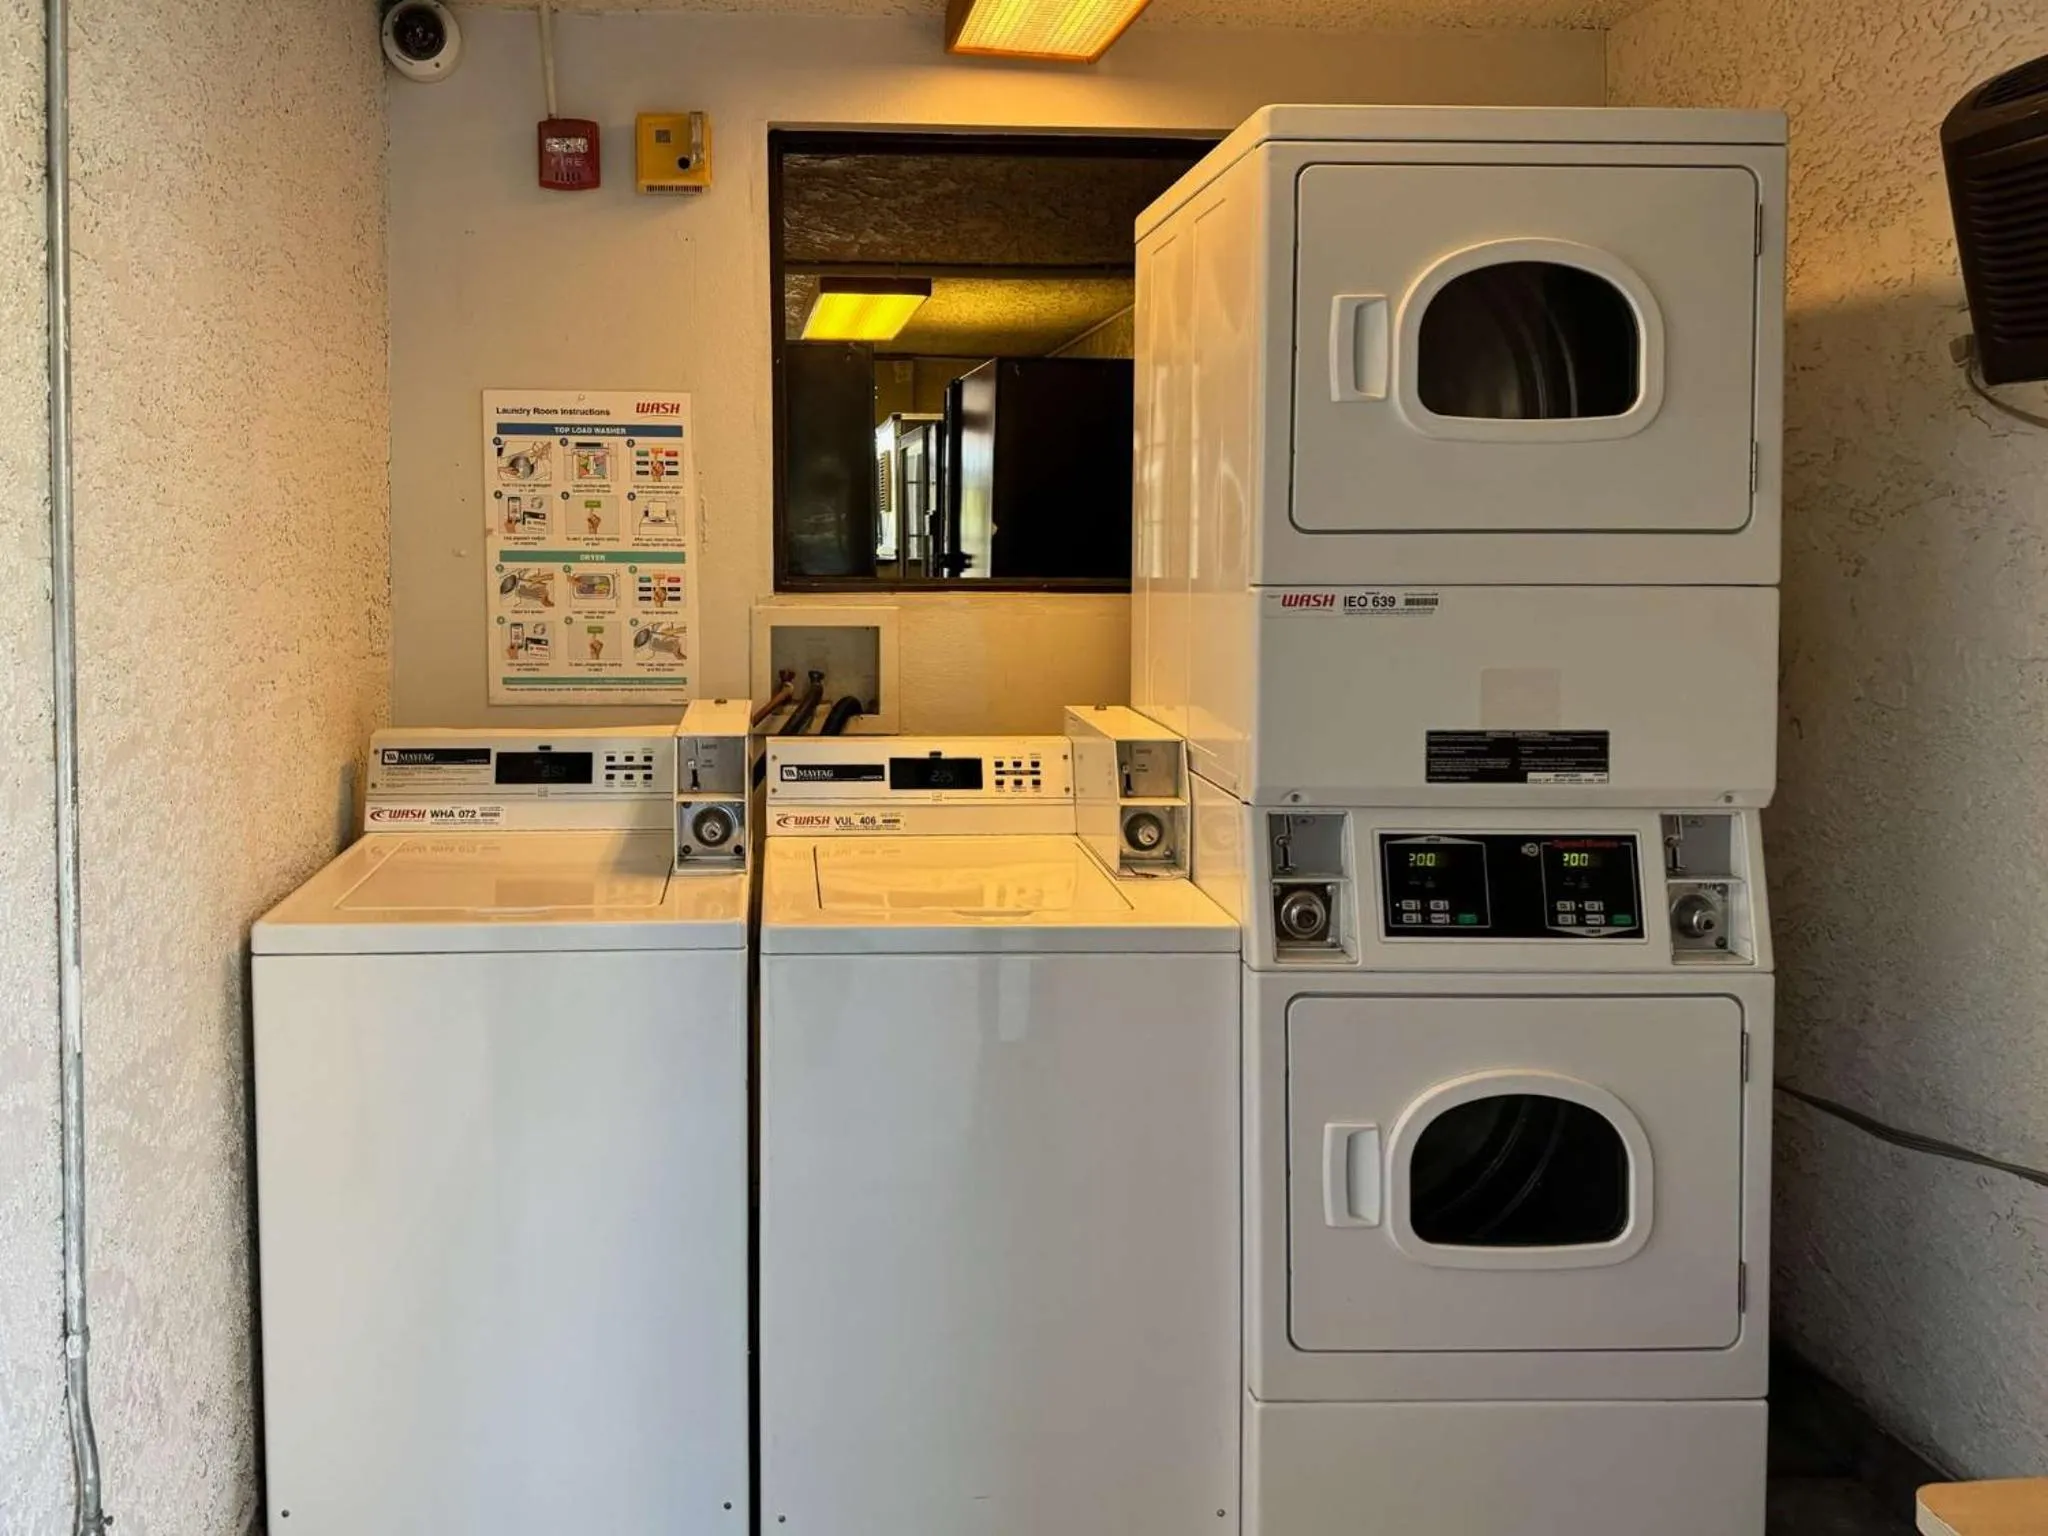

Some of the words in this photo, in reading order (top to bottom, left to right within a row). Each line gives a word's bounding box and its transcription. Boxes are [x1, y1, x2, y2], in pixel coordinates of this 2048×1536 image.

[496, 407, 531, 417] Laundry
[533, 408, 558, 416] Room
[561, 408, 611, 416] Instructions
[636, 402, 680, 414] WASH
[554, 426, 570, 434] TOP
[572, 427, 592, 435] LOAD
[594, 427, 626, 435] WASHER
[1281, 593, 1336, 608] WASH
[1343, 596, 1368, 607] IEO
[1372, 595, 1396, 607] 639
[388, 809, 427, 819] WASH
[430, 809, 455, 818] WHA
[458, 809, 477, 818] 072
[794, 815, 831, 825] WASH
[835, 816, 855, 825] VUL
[859, 816, 876, 825] 406
